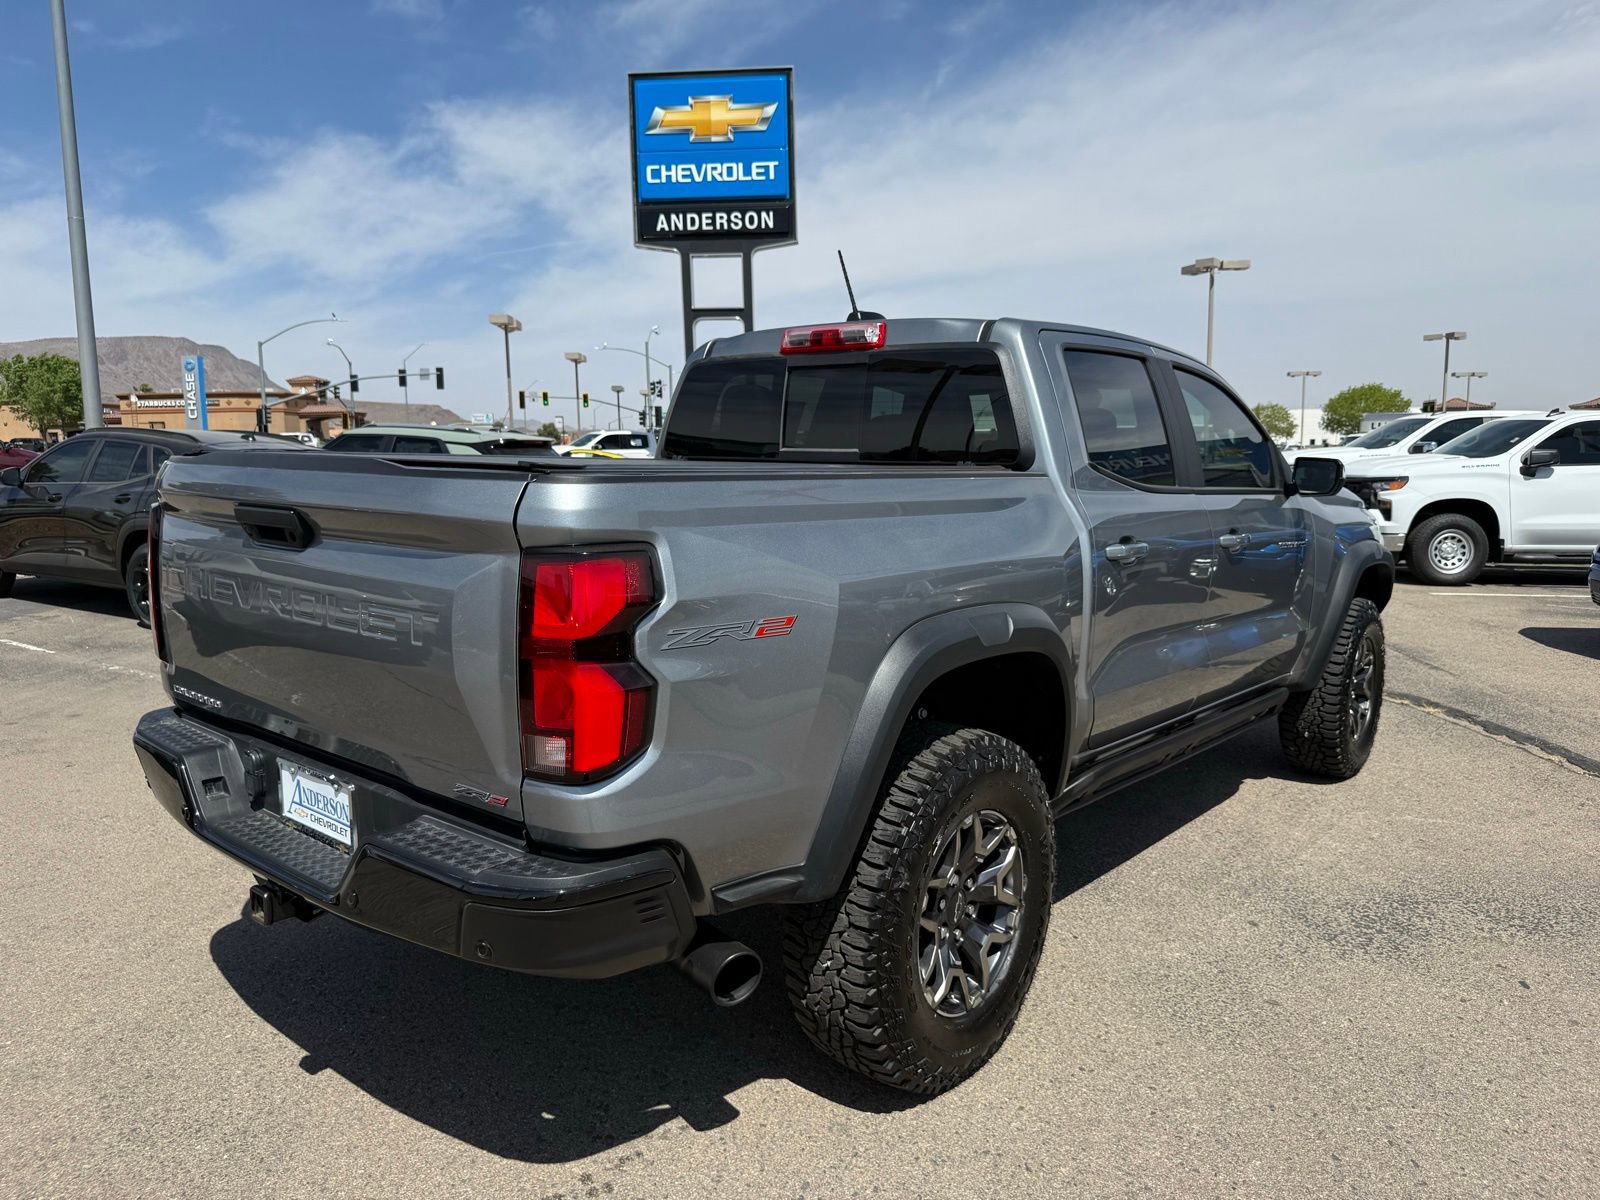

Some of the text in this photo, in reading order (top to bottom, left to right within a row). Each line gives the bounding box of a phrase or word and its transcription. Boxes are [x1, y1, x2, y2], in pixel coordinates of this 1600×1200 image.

[646, 161, 779, 184] CHEVROLET
[656, 211, 774, 231] ANDERSON
[137, 400, 176, 408] STARBUCKS
[185, 372, 198, 419] CHASE
[162, 562, 440, 647] CHEVROLET
[660, 614, 798, 651] ZR2
[288, 779, 350, 823] ANDERSON
[453, 783, 509, 807] ZR2
[310, 813, 349, 838] CHEVROLET
